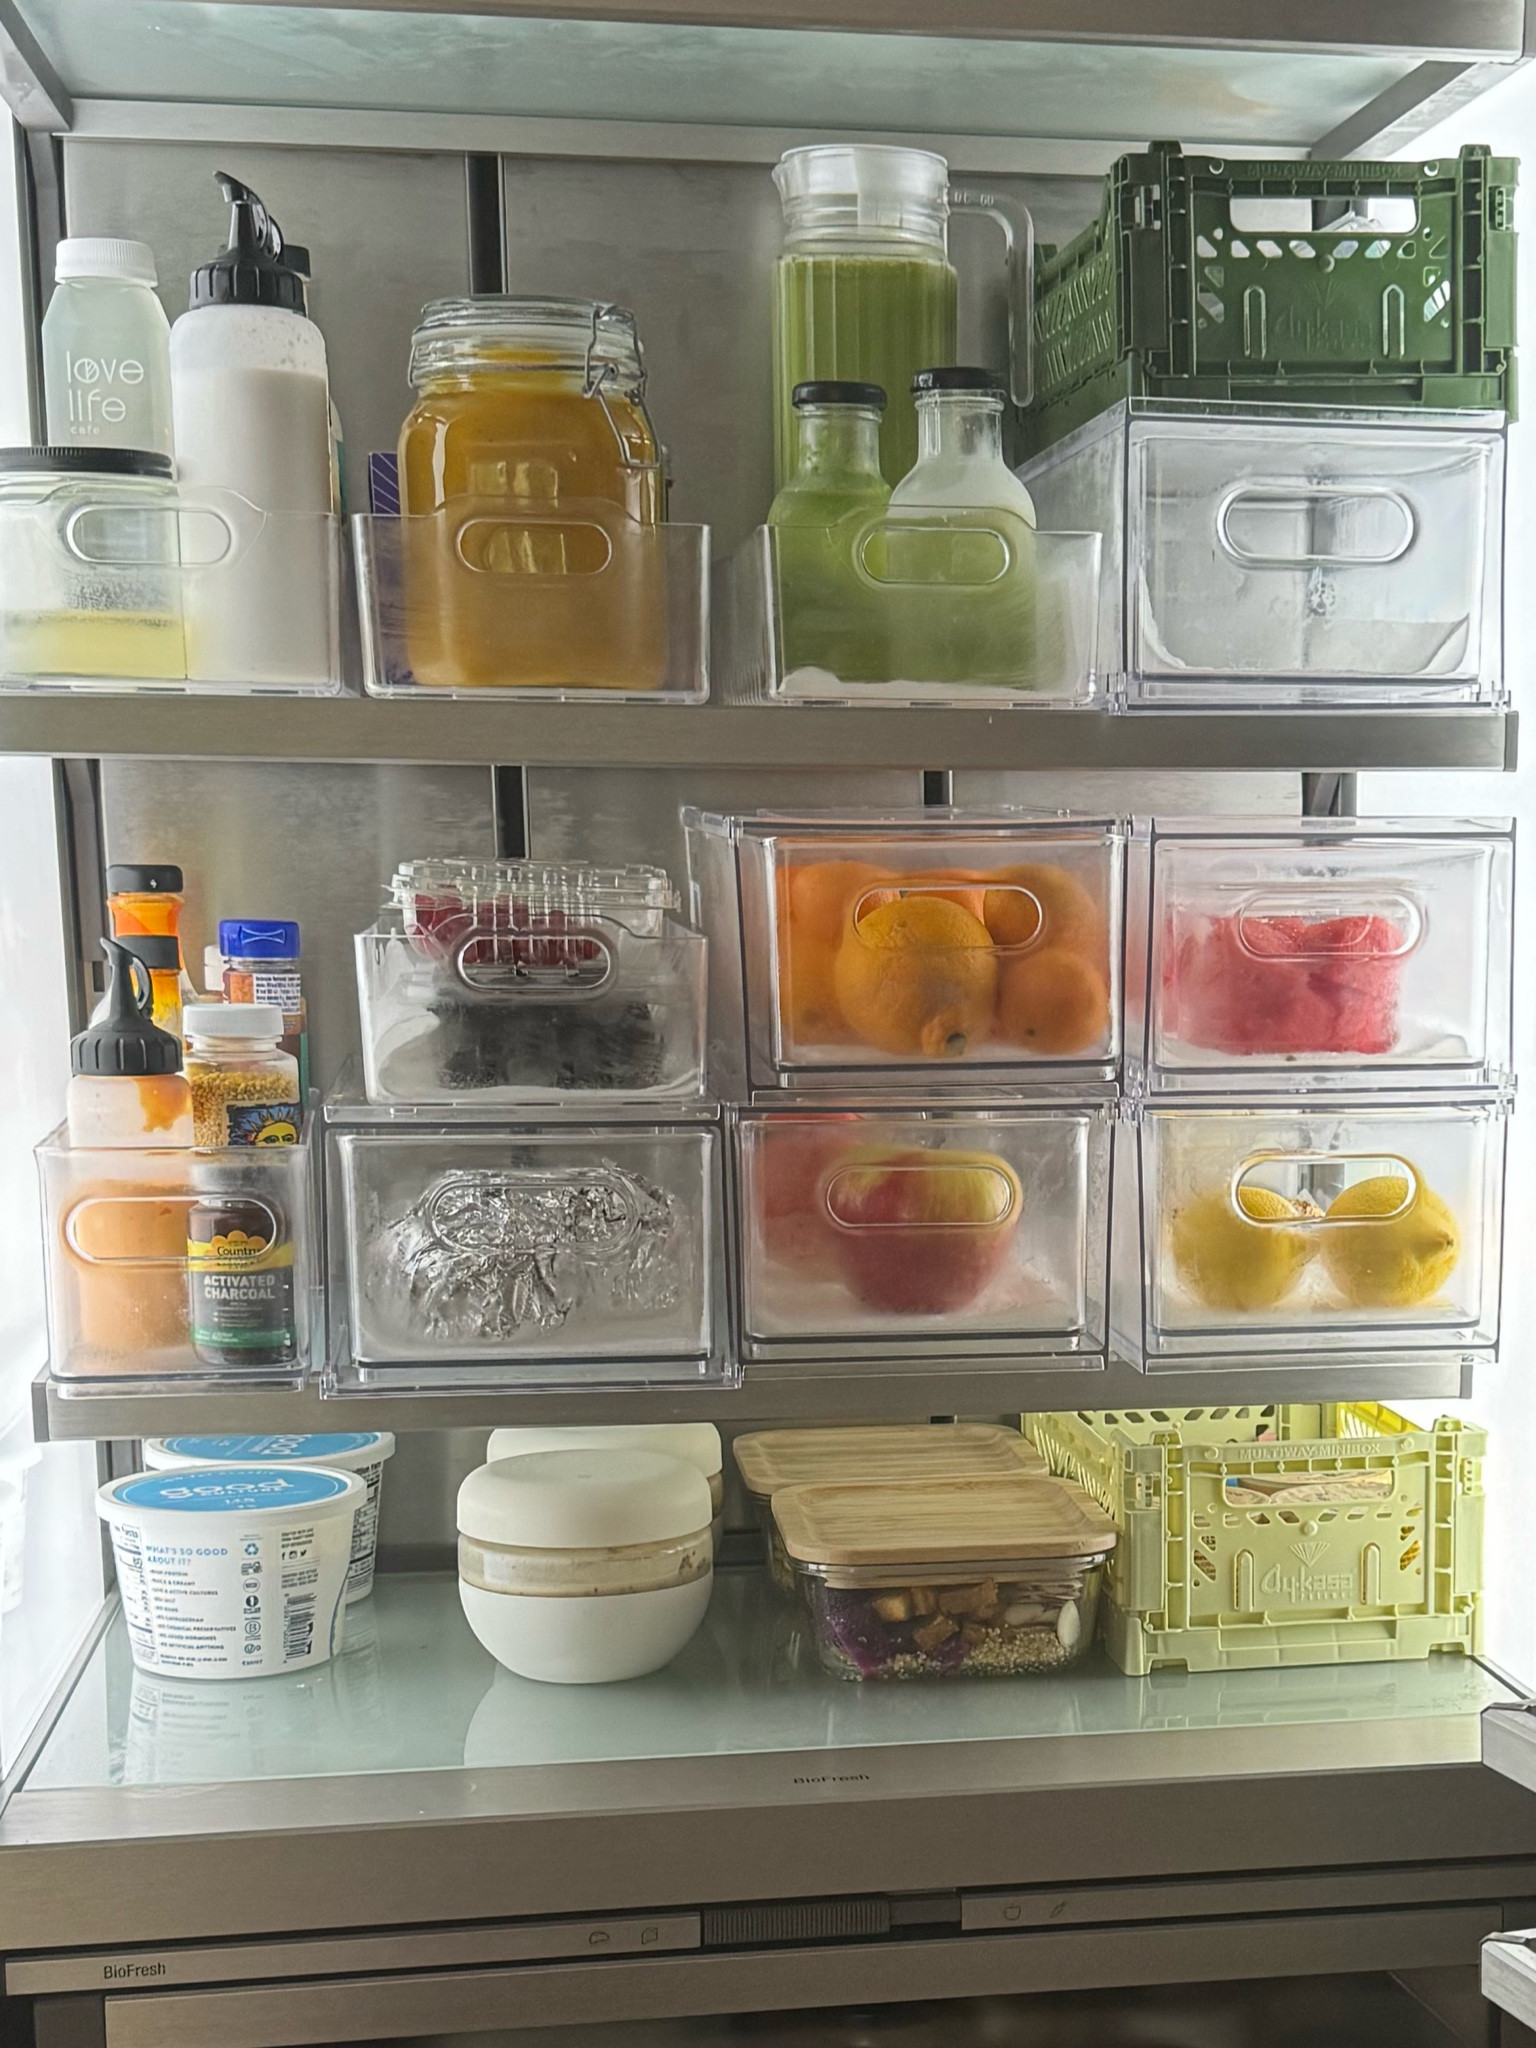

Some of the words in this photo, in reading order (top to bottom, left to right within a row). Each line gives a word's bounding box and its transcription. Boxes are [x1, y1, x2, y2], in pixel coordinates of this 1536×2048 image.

[66, 351, 144, 384] love
[69, 389, 126, 422] life
[203, 1275, 275, 1287] ACTIVATED
[204, 1287, 276, 1300] CHARCOAL
[159, 1478, 294, 1500] good
[180, 1548, 193, 1556] SO
[196, 1548, 228, 1556] GOOD
[148, 1556, 175, 1565] ABOUT
[103, 1962, 166, 1979] BioFresh
